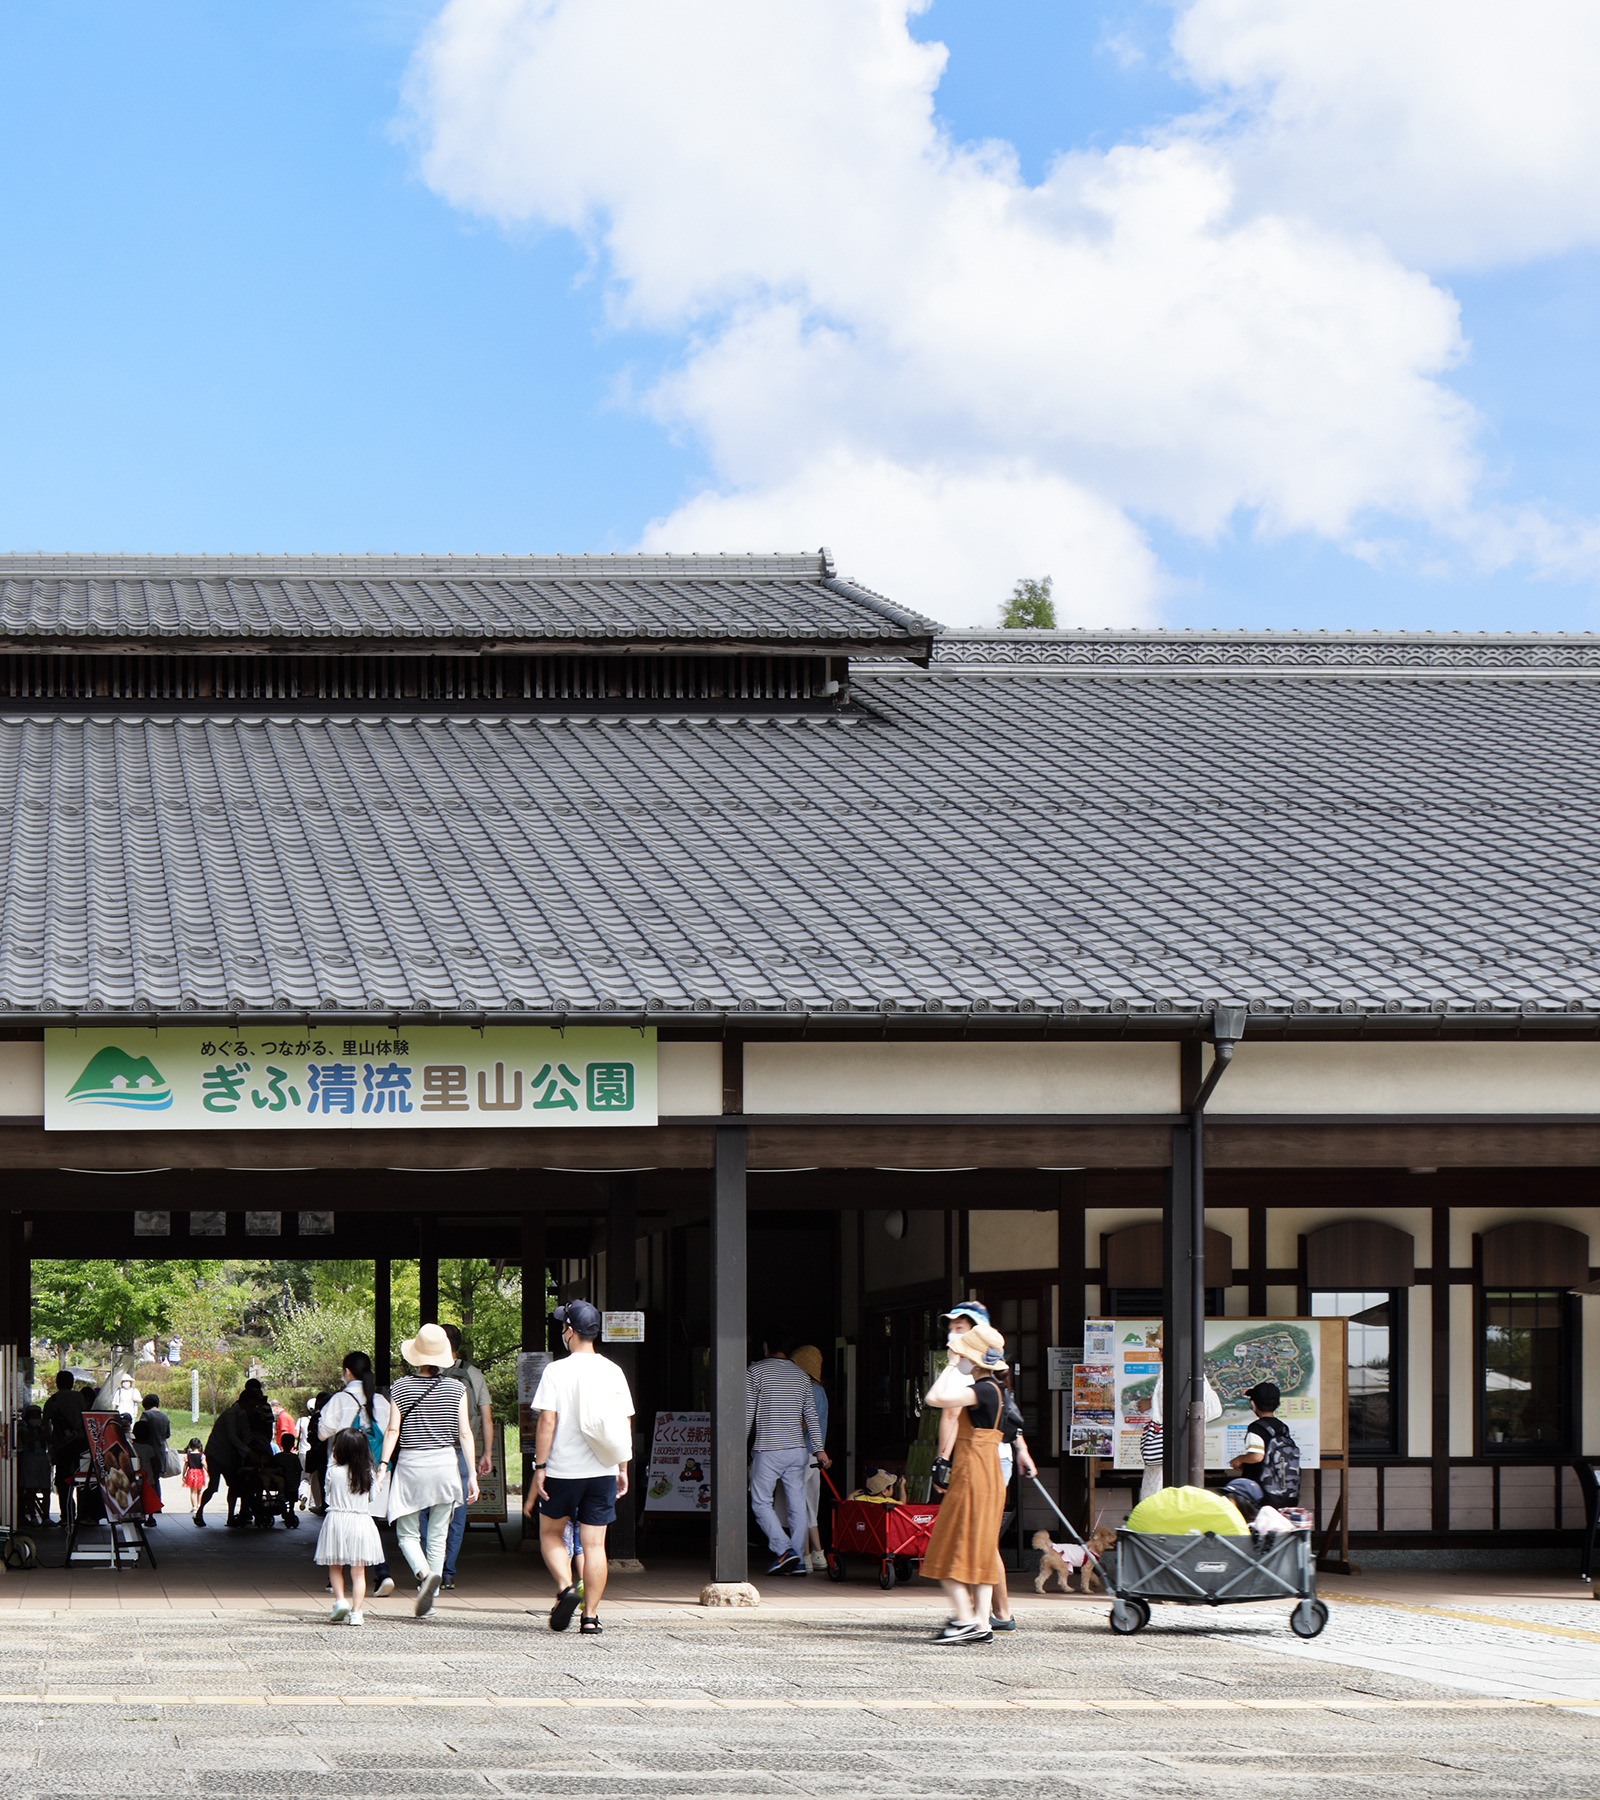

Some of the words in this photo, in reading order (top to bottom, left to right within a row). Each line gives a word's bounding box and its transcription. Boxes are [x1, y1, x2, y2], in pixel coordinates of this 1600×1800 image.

[200, 1039, 410, 1058] めぐる、つながる、里山体験
[201, 1061, 636, 1115] ぎふ清流里山公園
